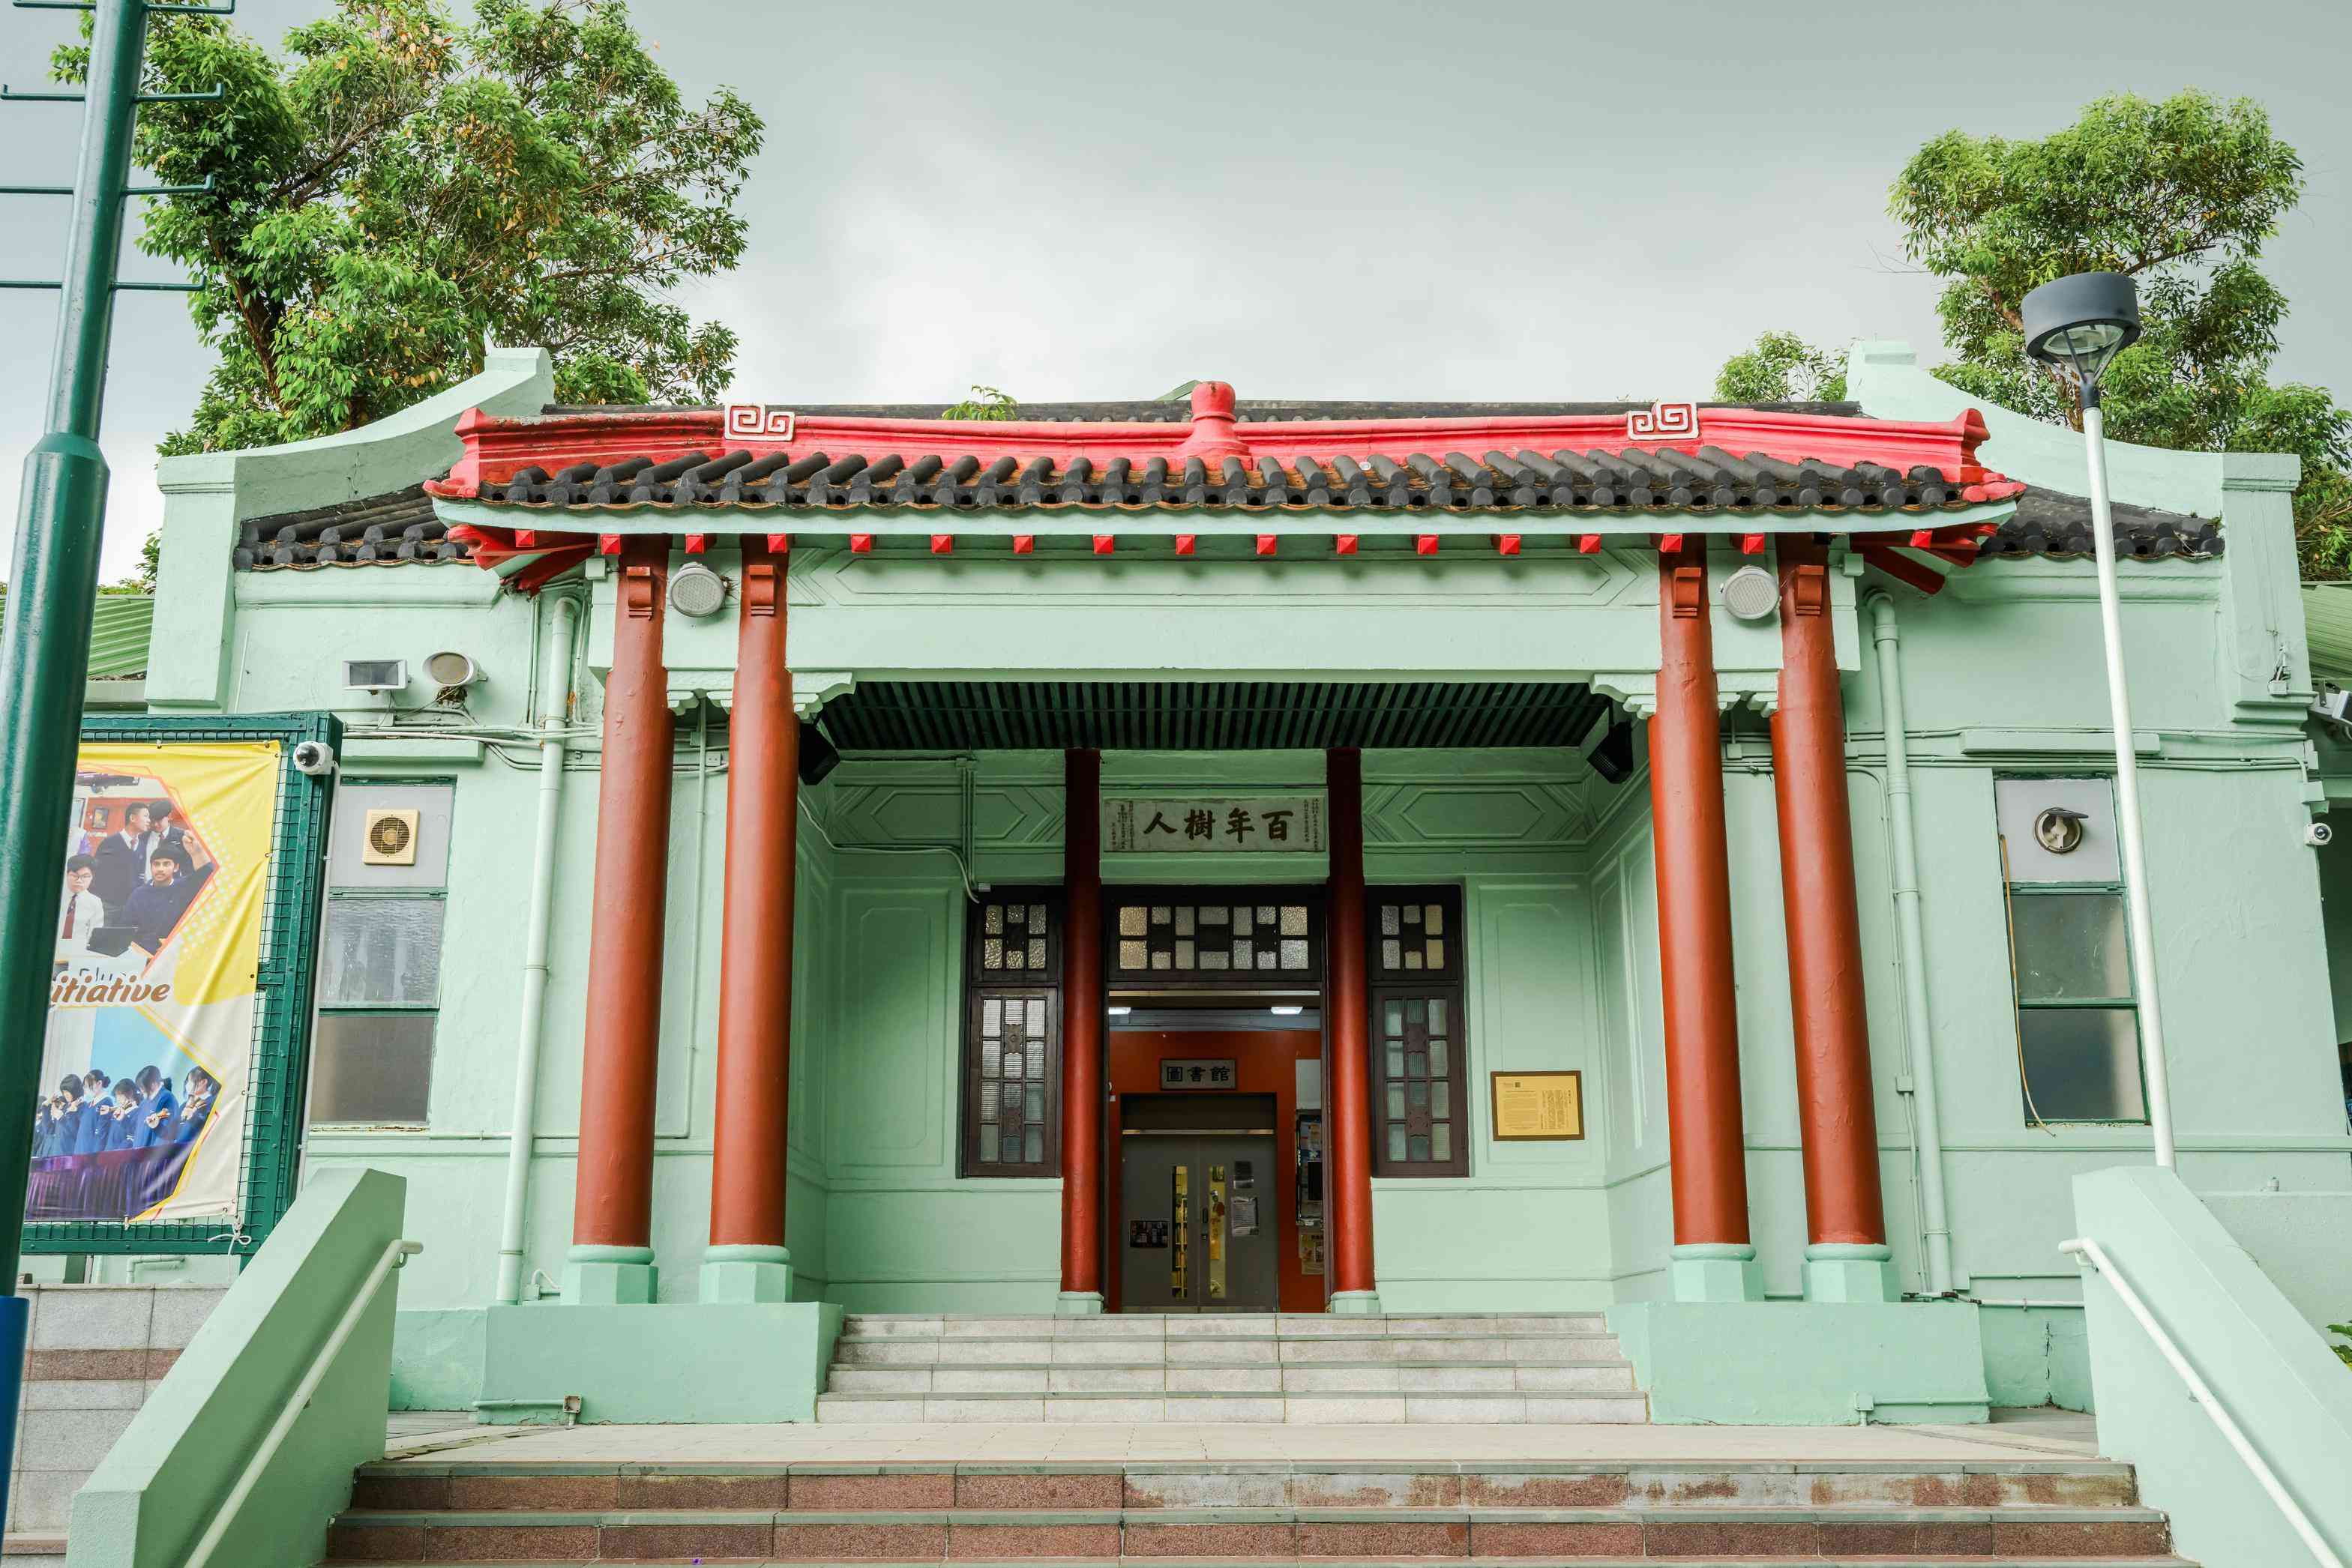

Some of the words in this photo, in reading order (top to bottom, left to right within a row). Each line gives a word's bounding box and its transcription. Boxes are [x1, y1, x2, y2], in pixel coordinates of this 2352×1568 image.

[1143, 807, 1293, 843] 百年樹人
[1166, 1065, 1230, 1082] 圖書館
